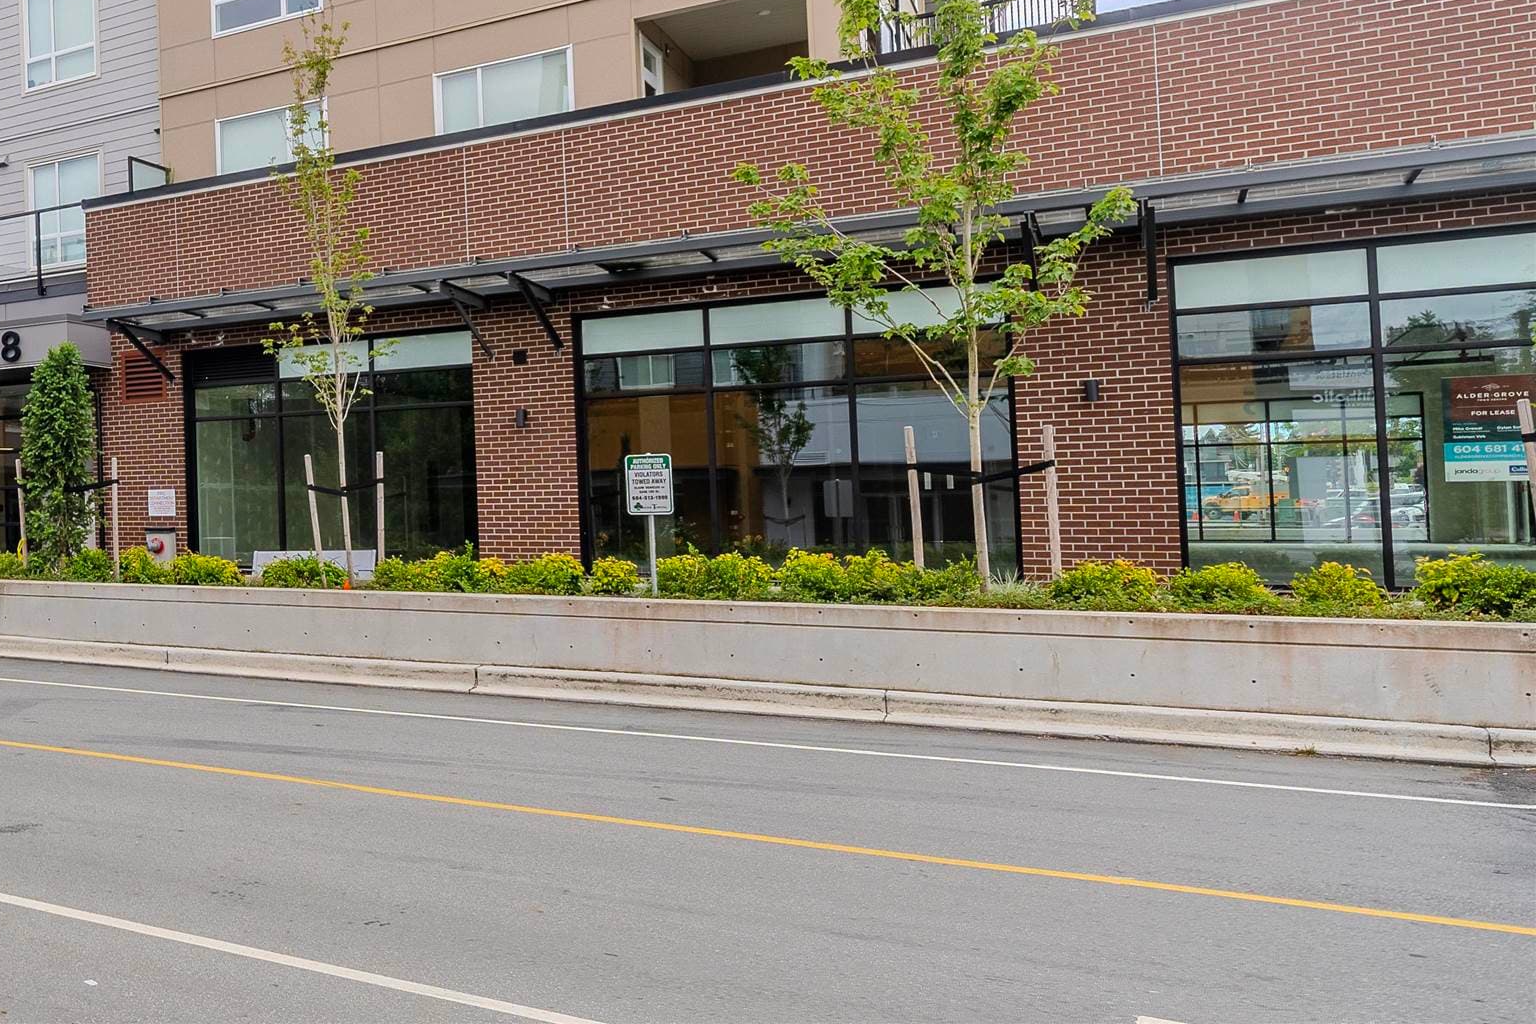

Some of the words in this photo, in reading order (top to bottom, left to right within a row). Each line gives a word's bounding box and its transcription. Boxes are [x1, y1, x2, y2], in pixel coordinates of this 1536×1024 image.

[1493, 390, 1529, 398] GROVE
[1453, 445, 1481, 454] 604
[1484, 444, 1508, 453] 681
